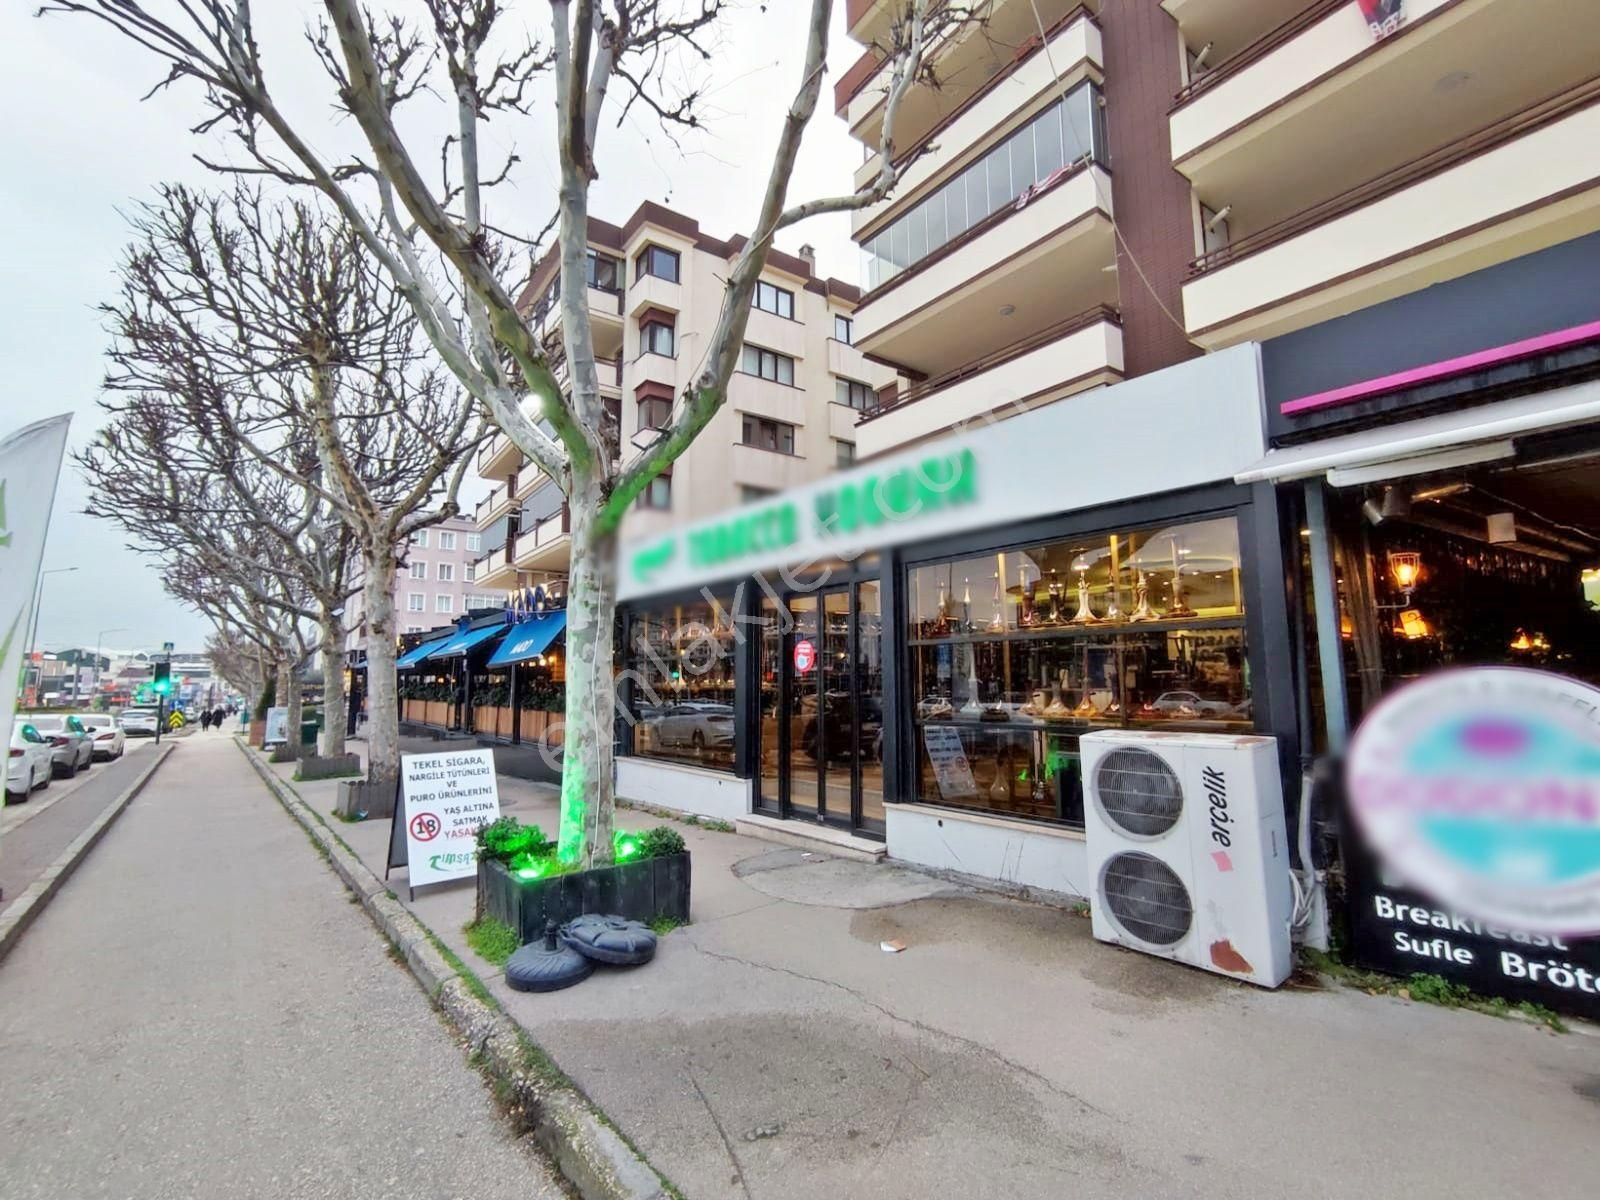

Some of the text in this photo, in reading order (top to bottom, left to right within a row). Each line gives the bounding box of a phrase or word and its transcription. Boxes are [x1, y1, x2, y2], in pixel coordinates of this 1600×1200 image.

[413, 756, 486, 770] TEKEL SİGARA,
[408, 766, 491, 782] NARGİLE TÜTÜNLERİ
[446, 780, 458, 789] VE
[411, 786, 493, 803] PURO ÜRÜNLERİNİ
[444, 803, 495, 815] YAŞ ALTINA
[1202, 765, 1235, 848] arçelik
[416, 819, 437, 835] 18
[452, 815, 489, 826] SATMAK
[445, 827, 478, 838] YASAK
[1393, 931, 1475, 965] Sufle
